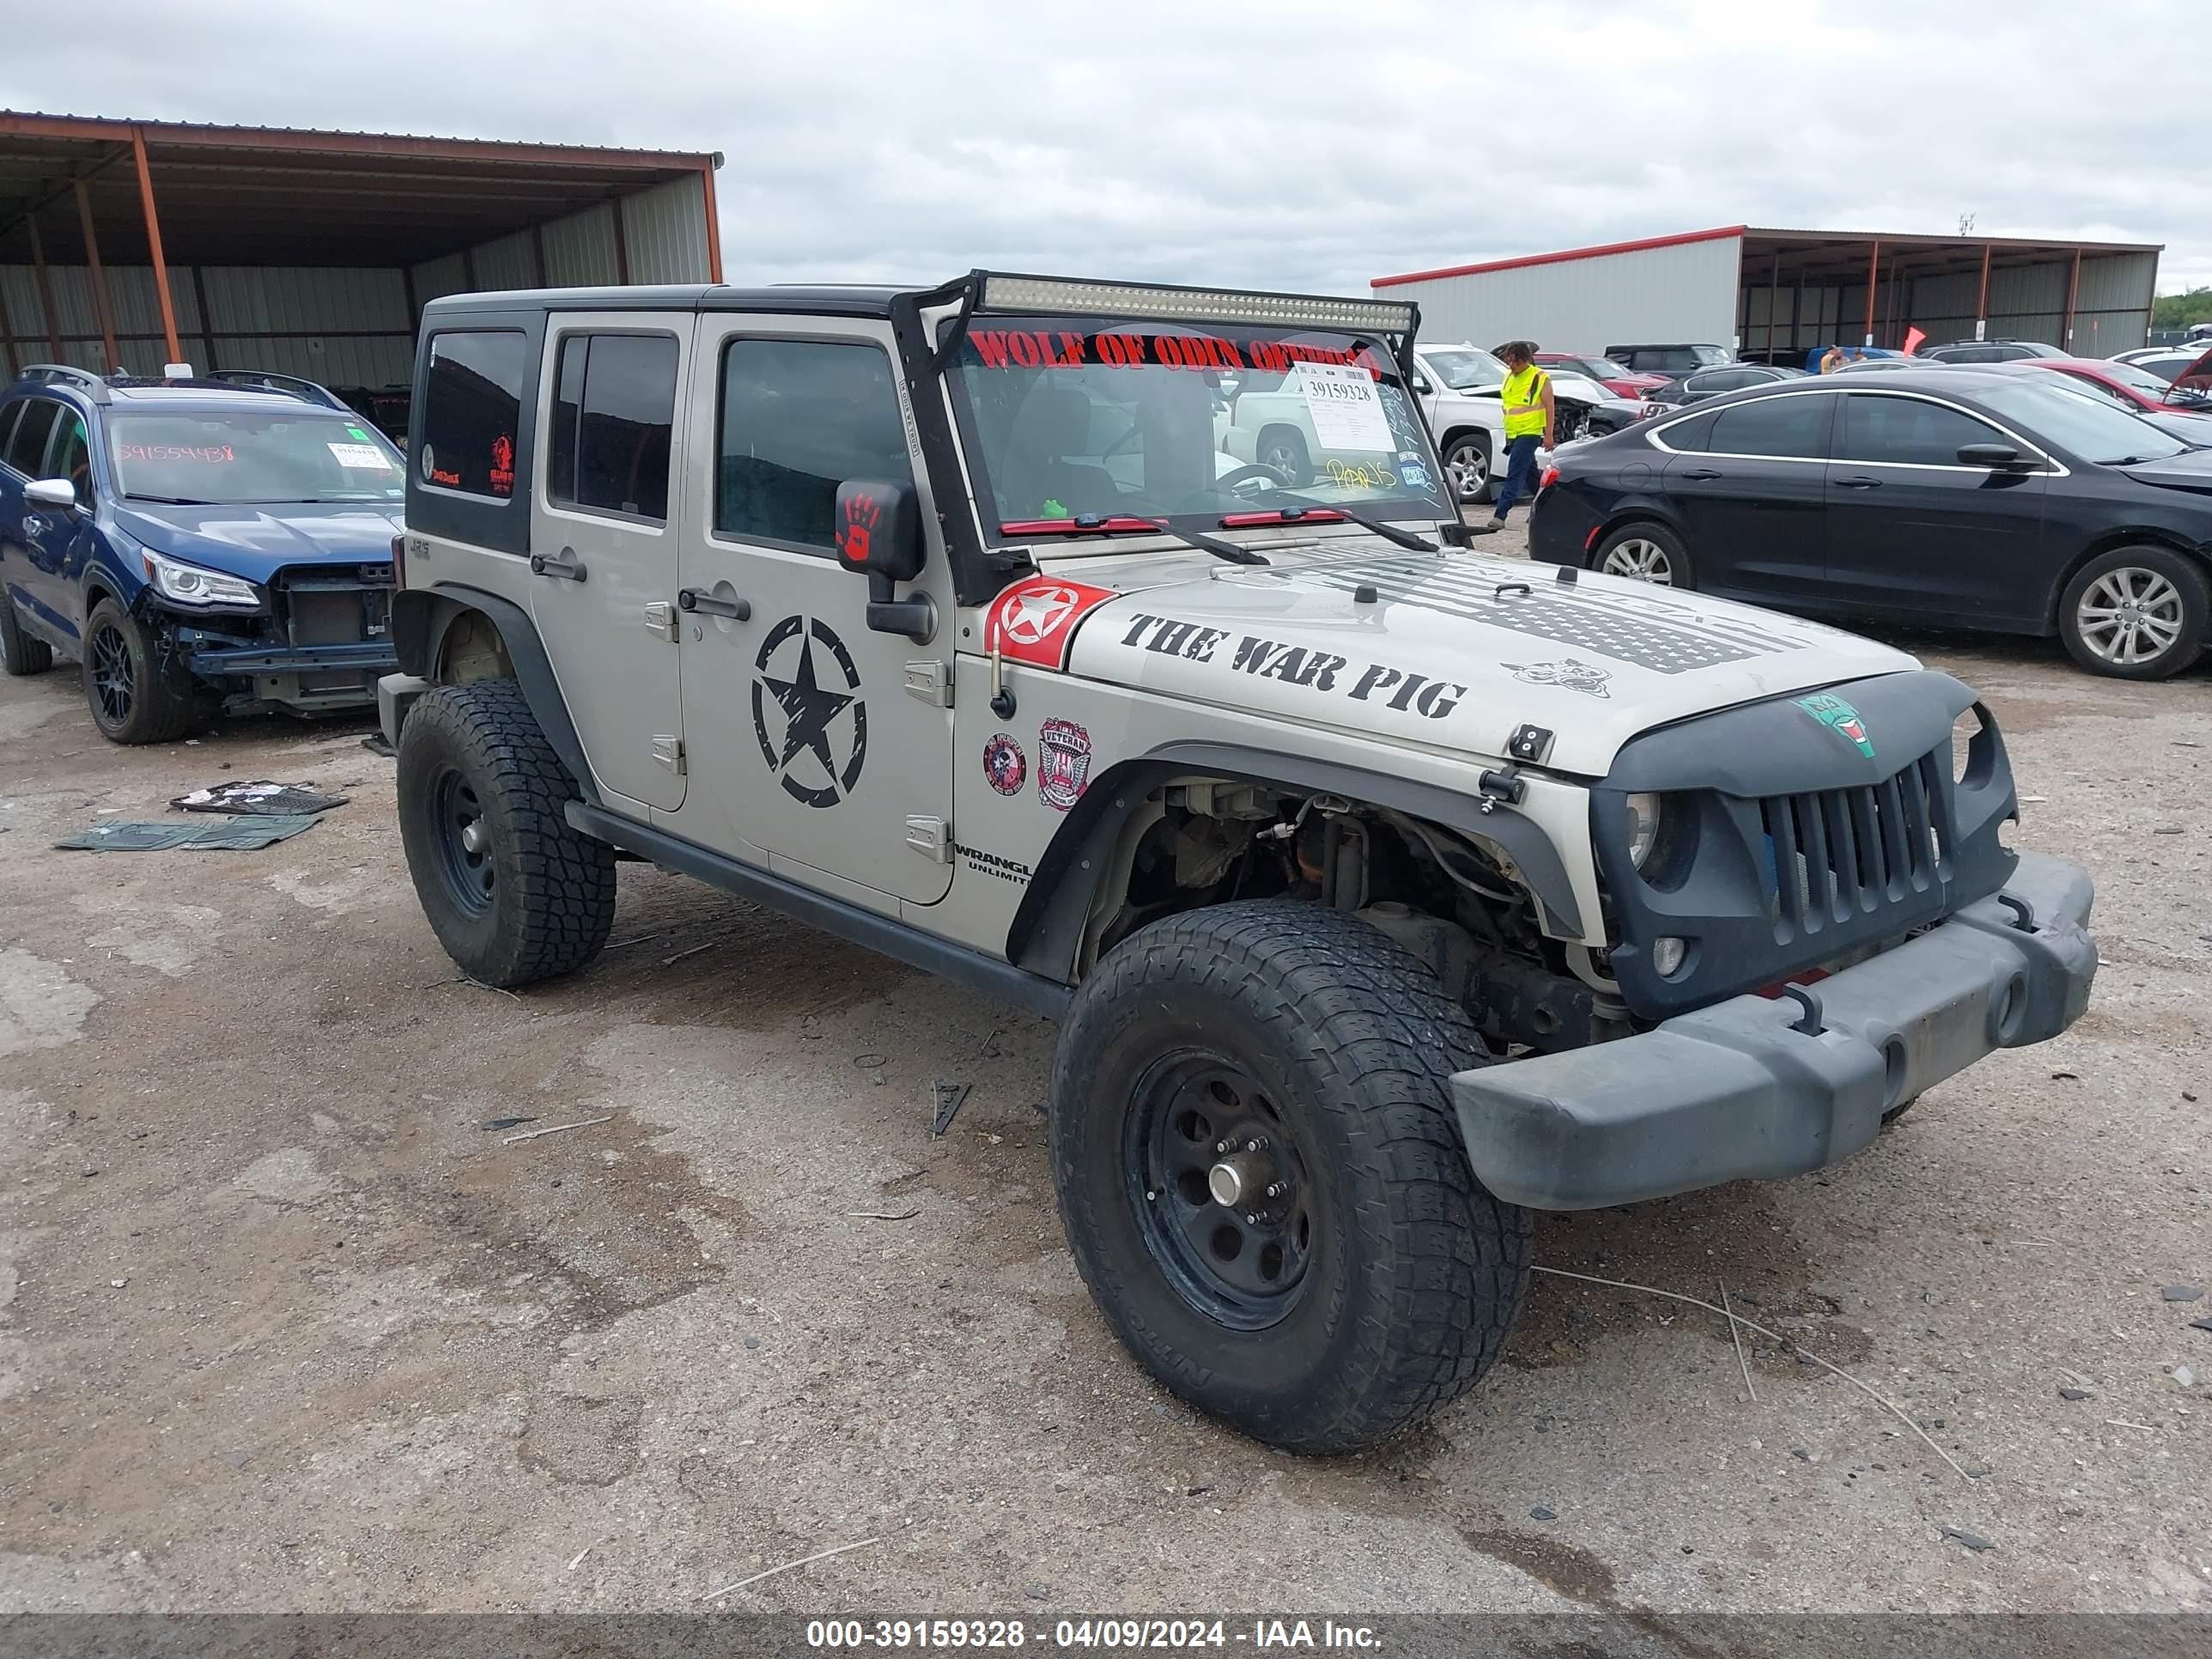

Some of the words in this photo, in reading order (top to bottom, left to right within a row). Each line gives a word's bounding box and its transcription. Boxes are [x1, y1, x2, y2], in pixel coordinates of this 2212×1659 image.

[968, 330, 1086, 370] WOLF
[1096, 333, 1146, 370] OF
[1154, 336, 1245, 372] ODIN
[1310, 380, 1371, 402] 39159328
[1120, 612, 1232, 664] THE
[1231, 635, 1347, 692] WAR
[1347, 663, 1469, 720] PIG
[1046, 731, 1085, 751] VETERAN
